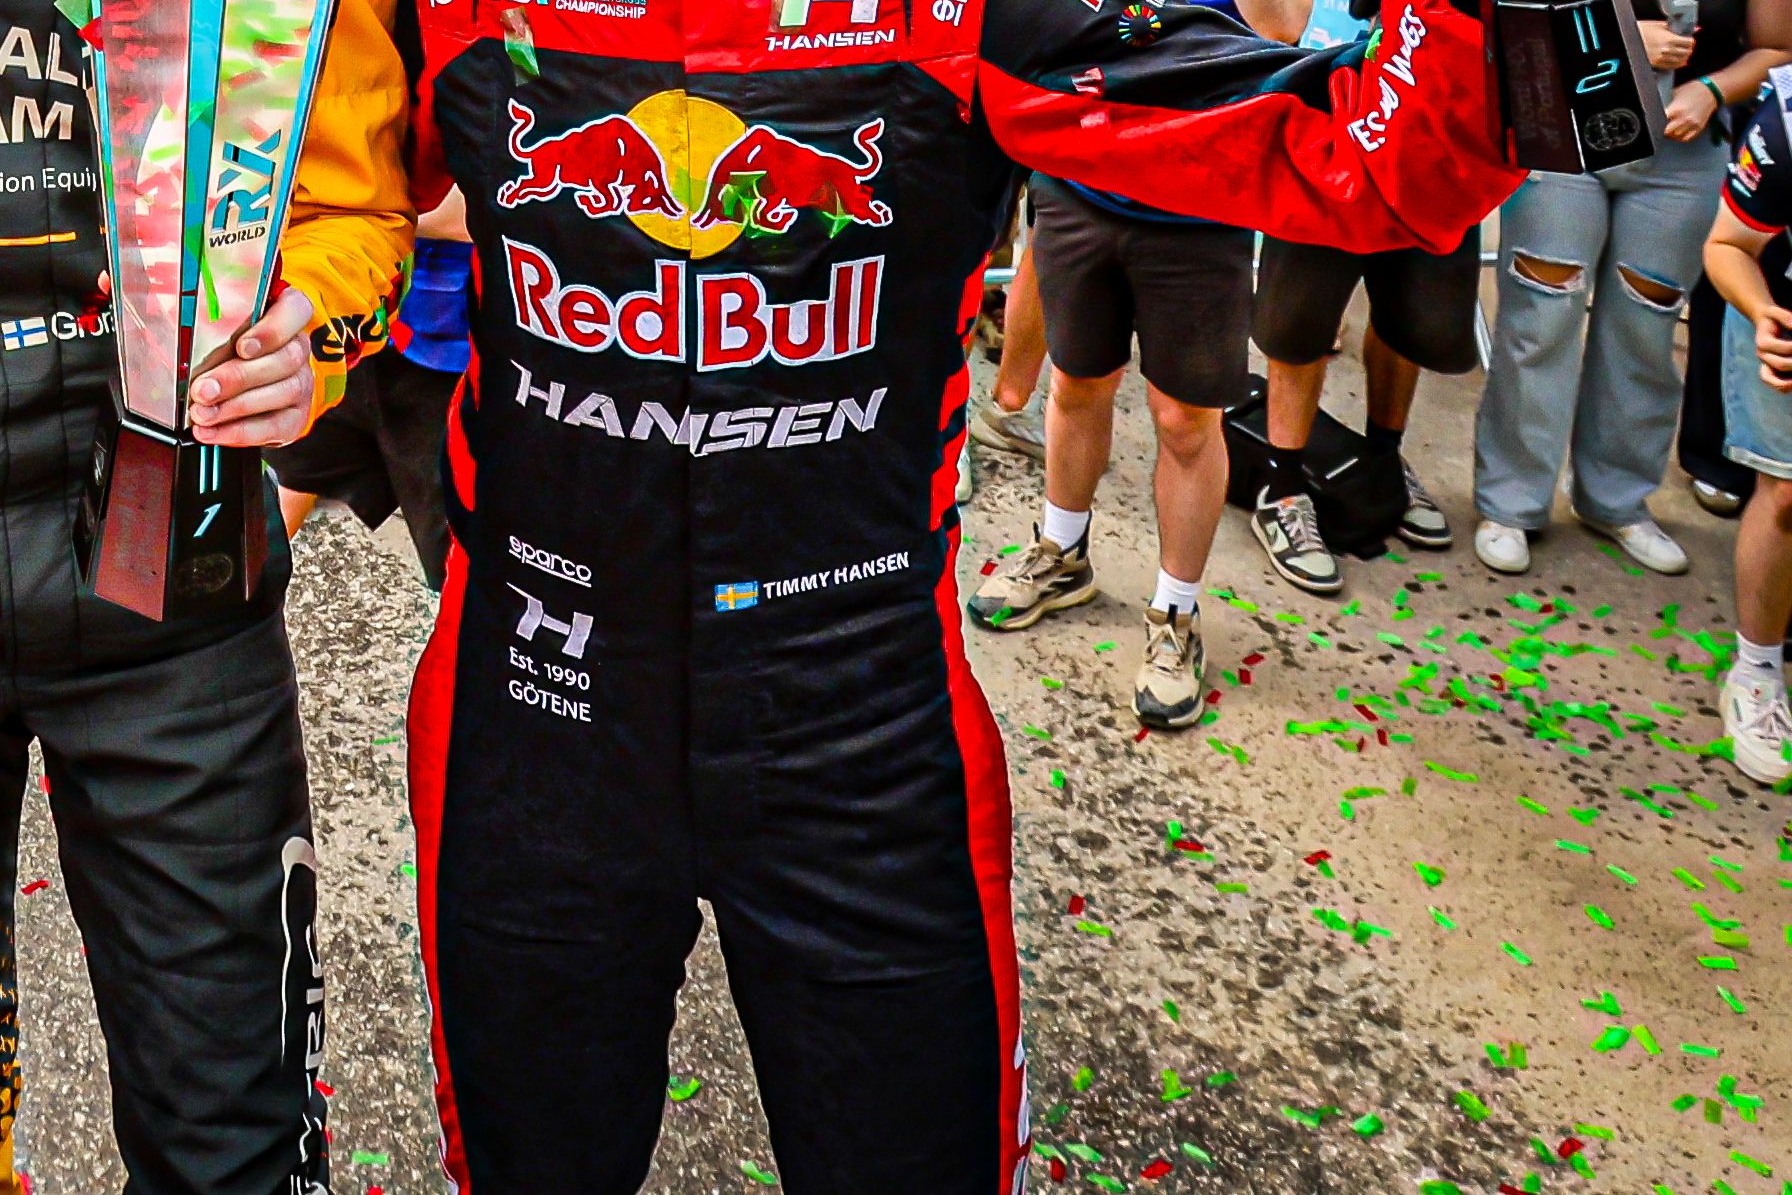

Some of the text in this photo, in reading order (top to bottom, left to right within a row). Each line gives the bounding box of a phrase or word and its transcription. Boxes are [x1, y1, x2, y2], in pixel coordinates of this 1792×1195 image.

[764, 28, 896, 52] HANSEN
[213, 129, 282, 236] RX
[208, 225, 267, 250] WORLD
[502, 236, 885, 372] Red Bull
[509, 358, 888, 458] HANSEN
[508, 535, 592, 584] sparco
[763, 551, 910, 600] TIMMY HANSEN
[509, 645, 591, 691] Est. 1990
[508, 678, 592, 723] GÖTENE
